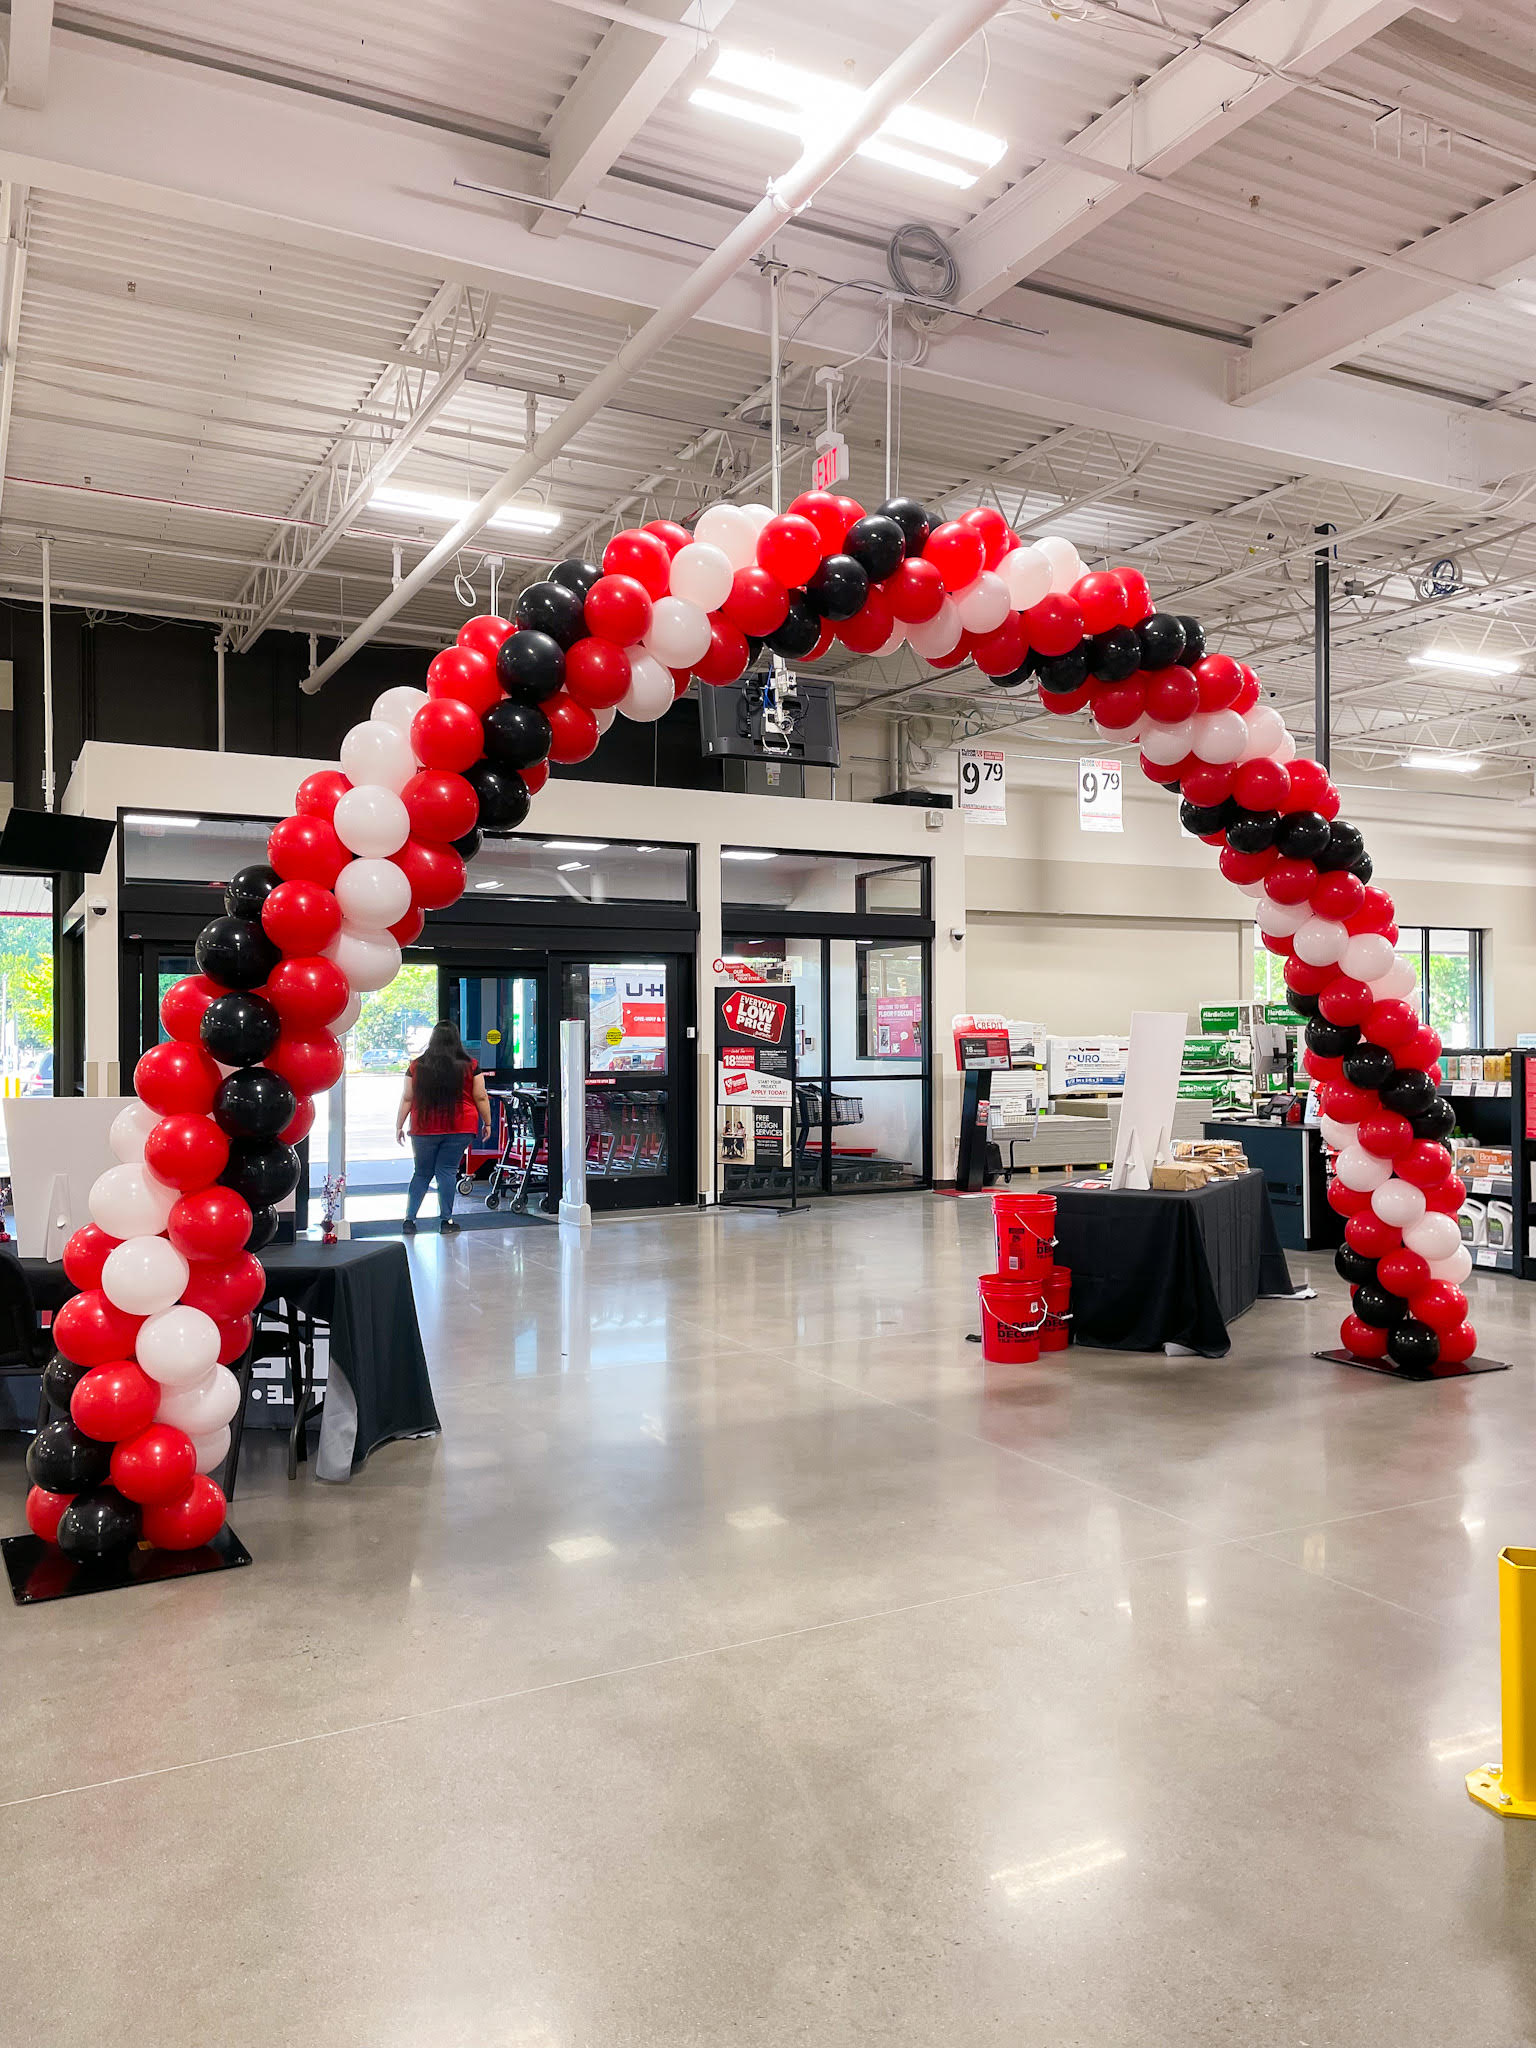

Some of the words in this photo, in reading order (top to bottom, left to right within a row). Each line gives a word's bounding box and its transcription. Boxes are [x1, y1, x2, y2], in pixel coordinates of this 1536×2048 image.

[817, 447, 837, 490] EXIT
[962, 762, 980, 795] 9
[983, 762, 1003, 781] 79
[1082, 772, 1098, 804] 9
[1101, 773, 1120, 790] 79
[740, 995, 778, 1012] EVERYDAY
[738, 1003, 775, 1024] LOW
[736, 1015, 772, 1034] PRICE
[976, 1022, 1004, 1030] CREDIT
[723, 1055, 736, 1067] 18
[1479, 1152, 1498, 1162] Bona
